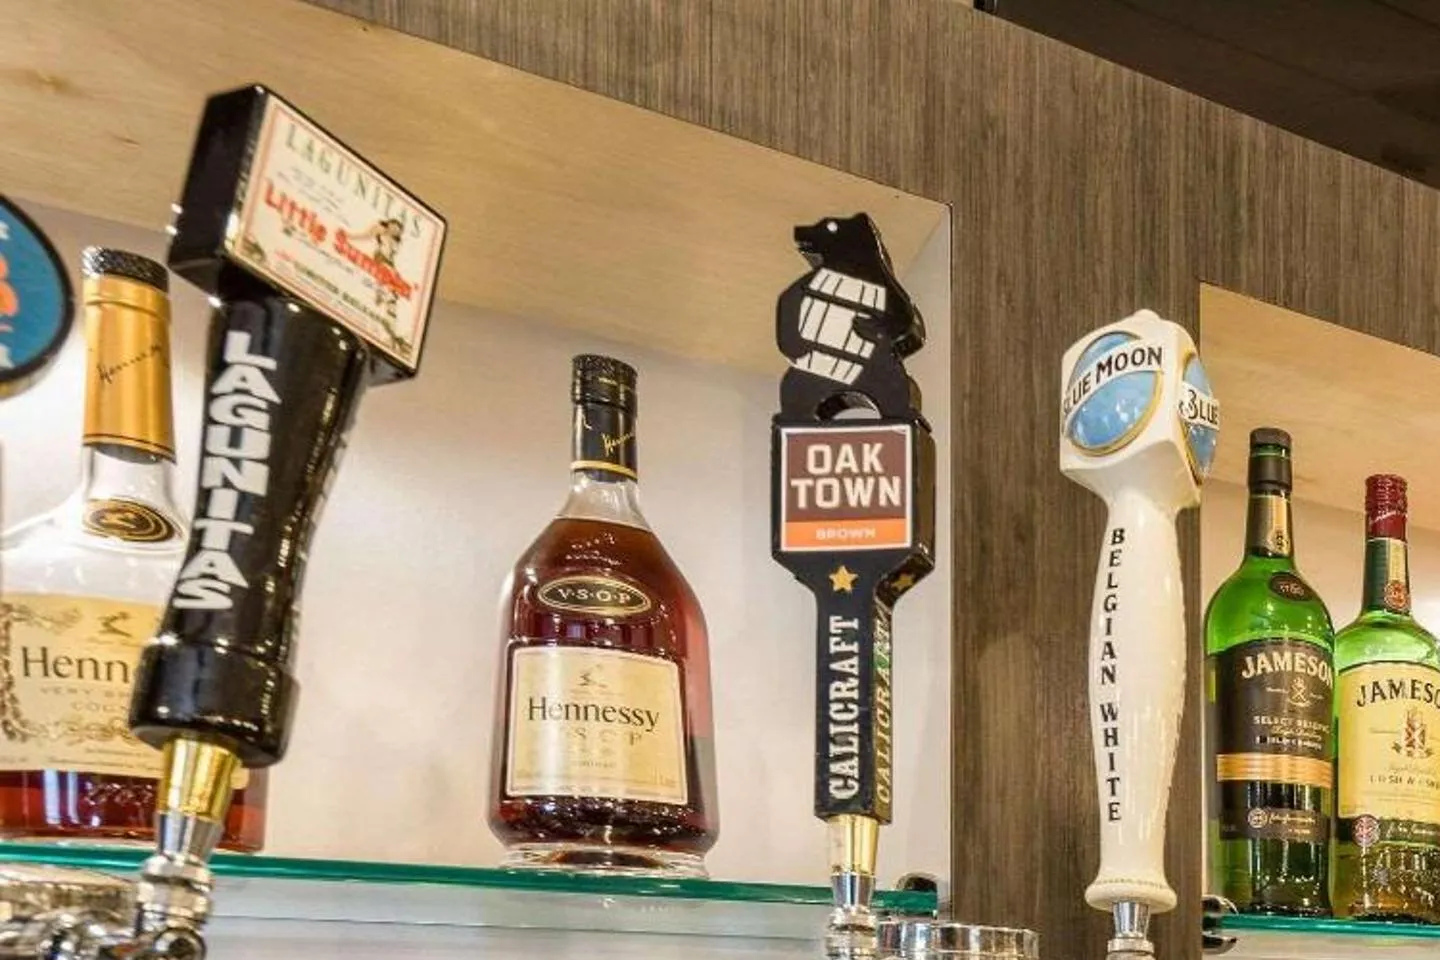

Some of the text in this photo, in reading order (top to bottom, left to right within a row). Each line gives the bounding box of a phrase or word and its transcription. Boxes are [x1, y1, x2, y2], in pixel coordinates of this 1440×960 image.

[1096, 347, 1163, 384] MOON
[173, 330, 281, 610] LAGUNITAS
[806, 442, 885, 475] OAK
[790, 474, 902, 510] TOWN
[816, 527, 877, 541] BROWN
[22, 646, 130, 684] Henn
[1100, 528, 1126, 822] BELGIAN WHITE
[1242, 651, 1333, 689] JAMESON
[528, 697, 660, 733] Hennessy
[828, 615, 860, 801] CALICRAFT
